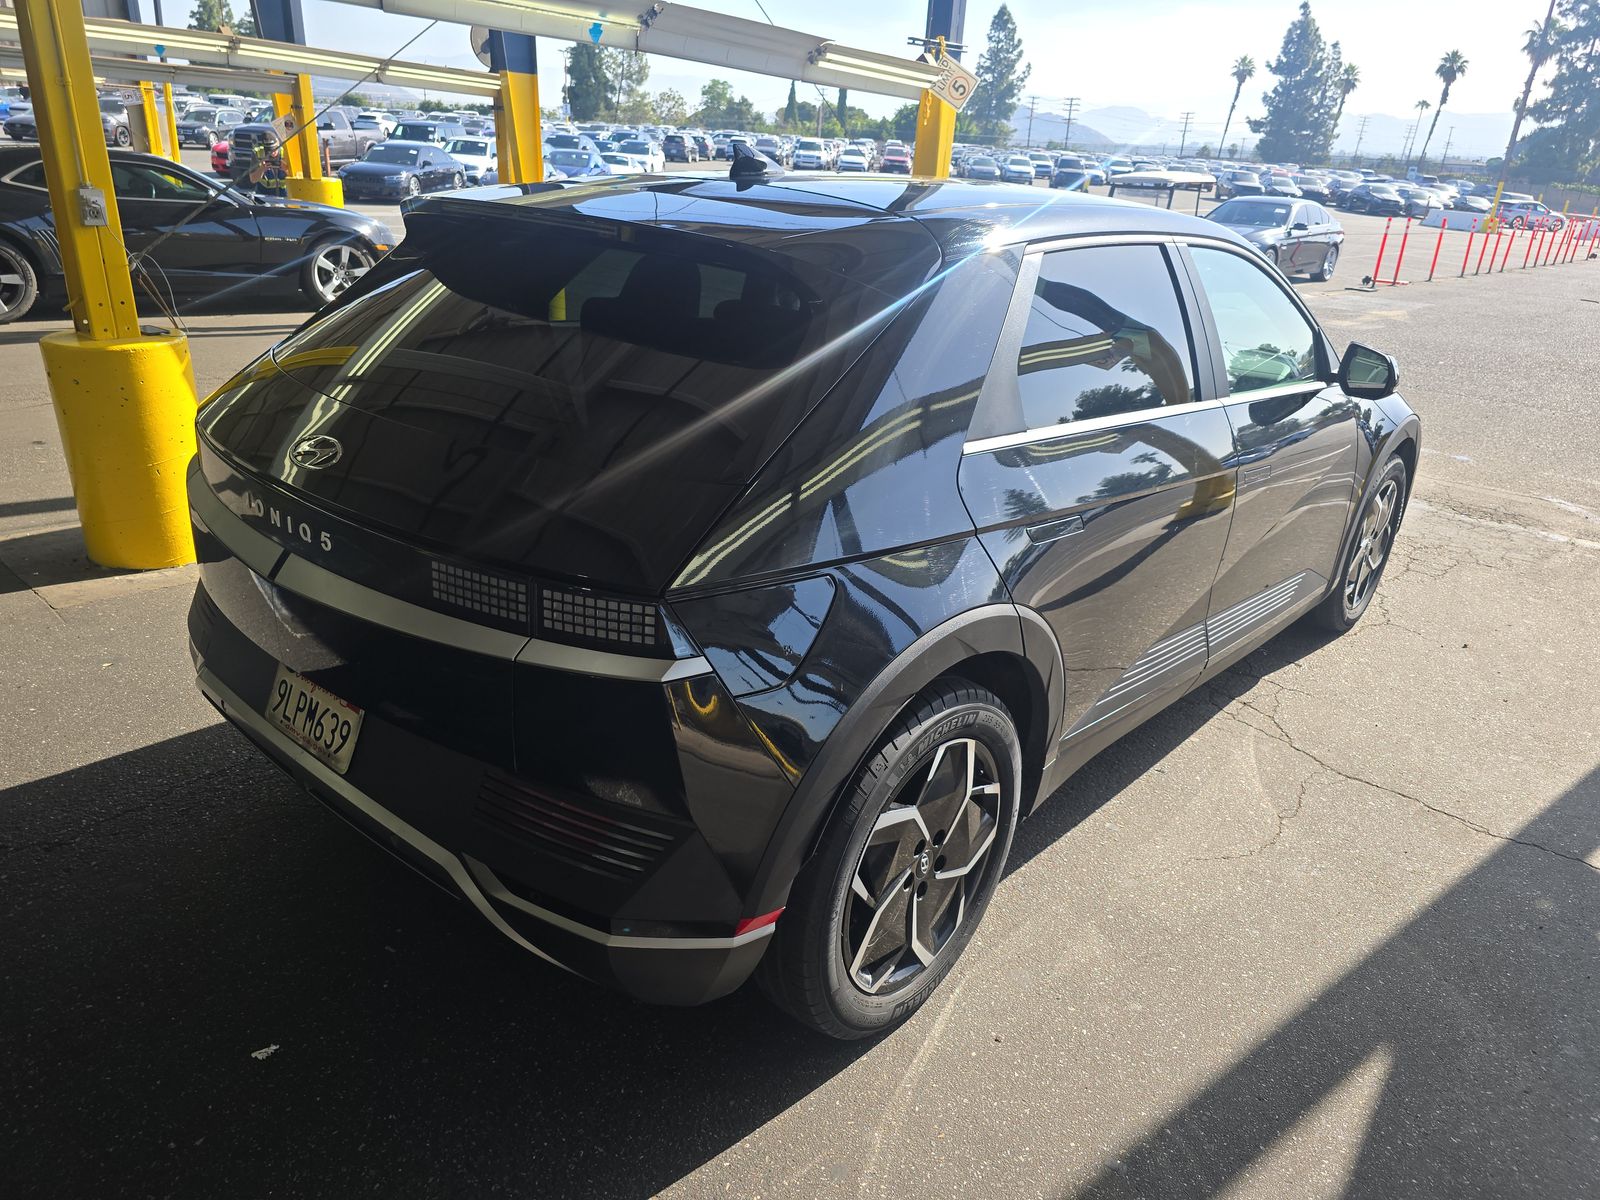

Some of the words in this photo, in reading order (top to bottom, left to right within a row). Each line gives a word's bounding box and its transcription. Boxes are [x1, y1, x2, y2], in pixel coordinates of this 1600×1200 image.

[952, 79, 967, 96] 5
[247, 491, 312, 543] IONIQ
[320, 531, 332, 552] 5
[272, 679, 351, 755] 9LPM639
[918, 713, 977, 754] MICHELIN
